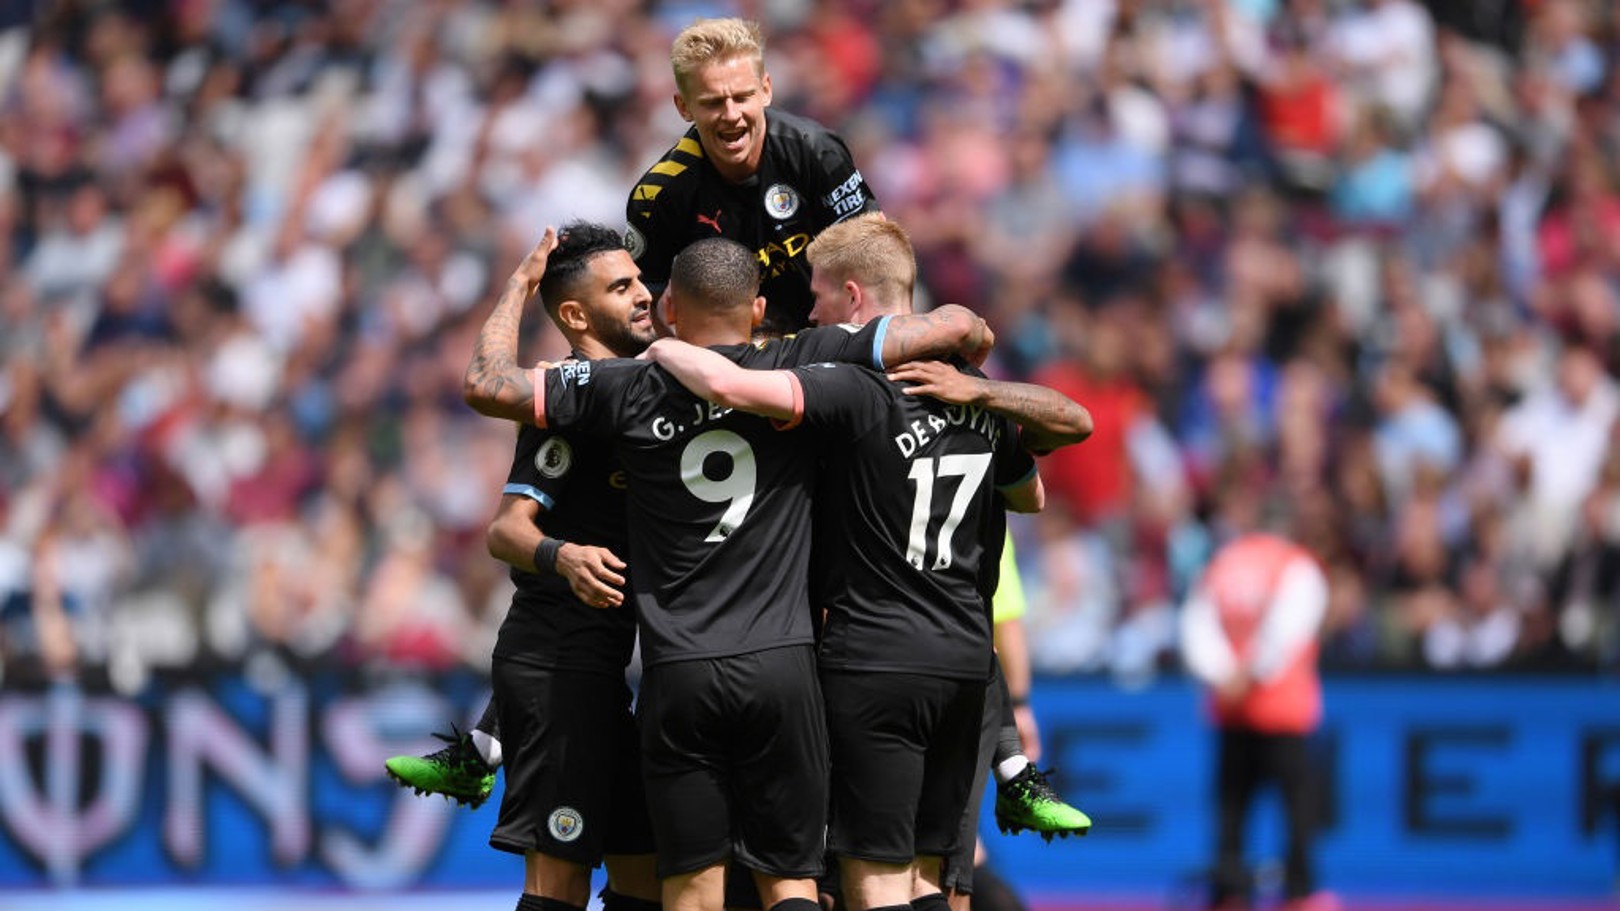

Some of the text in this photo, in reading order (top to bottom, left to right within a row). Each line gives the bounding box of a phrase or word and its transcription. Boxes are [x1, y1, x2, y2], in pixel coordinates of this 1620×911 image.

[822, 168, 863, 208] NEXEN
[651, 416, 685, 441] G.
[894, 419, 930, 459] DE
[680, 429, 757, 542] 9
[907, 452, 993, 571] 17
